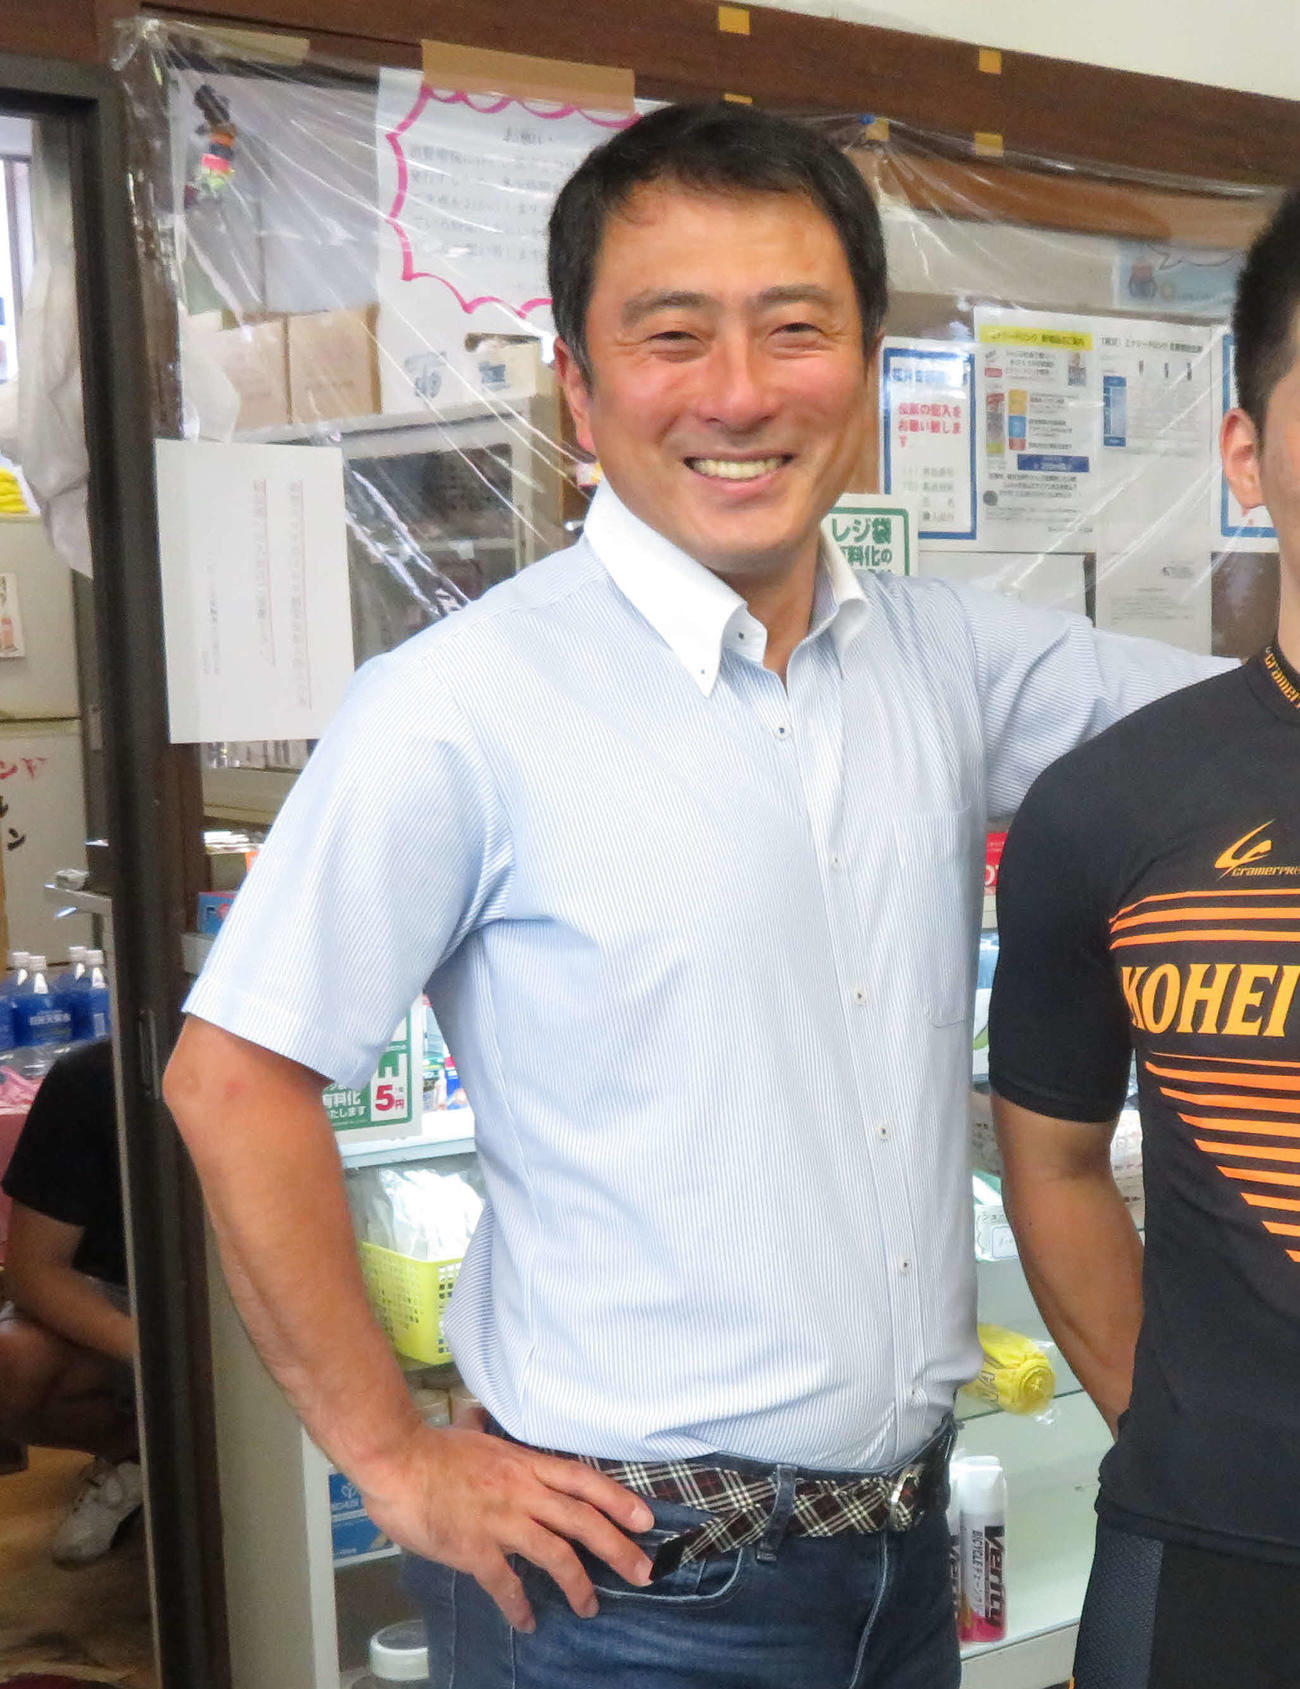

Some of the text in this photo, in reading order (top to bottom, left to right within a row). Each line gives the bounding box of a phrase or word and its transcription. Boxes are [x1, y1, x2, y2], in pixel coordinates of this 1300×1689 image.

[832, 517, 892, 544] レジ袋
[1121, 963, 1300, 1038] KOHEI
